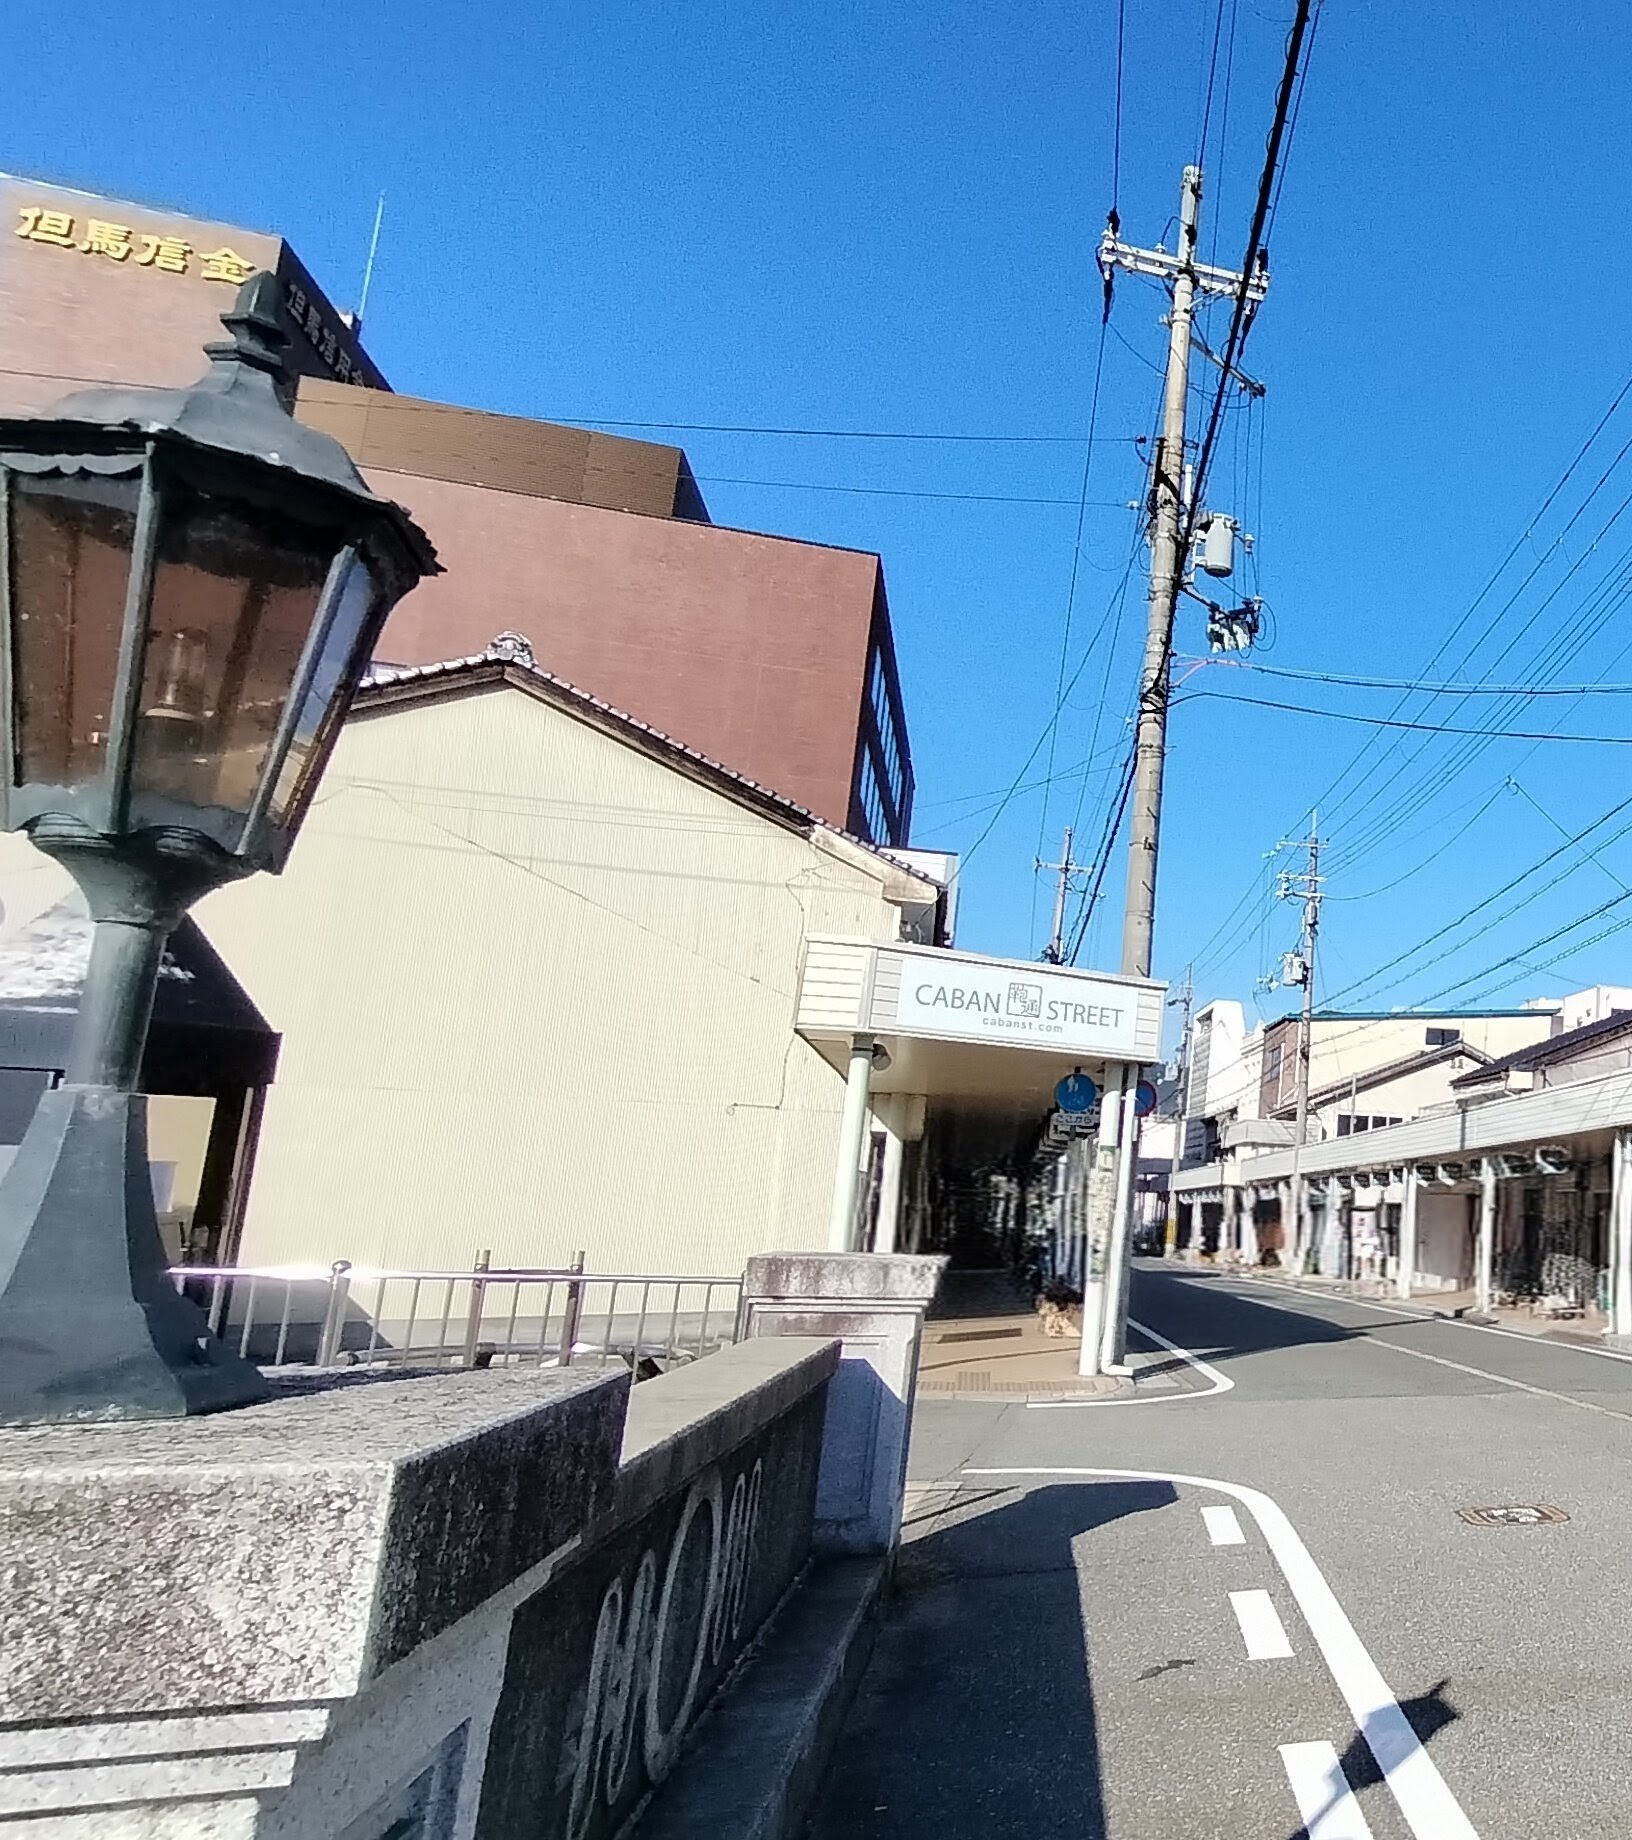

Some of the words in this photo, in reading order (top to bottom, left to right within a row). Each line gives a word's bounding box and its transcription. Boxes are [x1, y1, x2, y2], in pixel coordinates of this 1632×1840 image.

[13, 207, 256, 285] 但馬信金
[915, 984, 1001, 1014] CABAN
[1046, 1000, 1125, 1028] STREET
[982, 1017, 1063, 1033] cabanst.com
